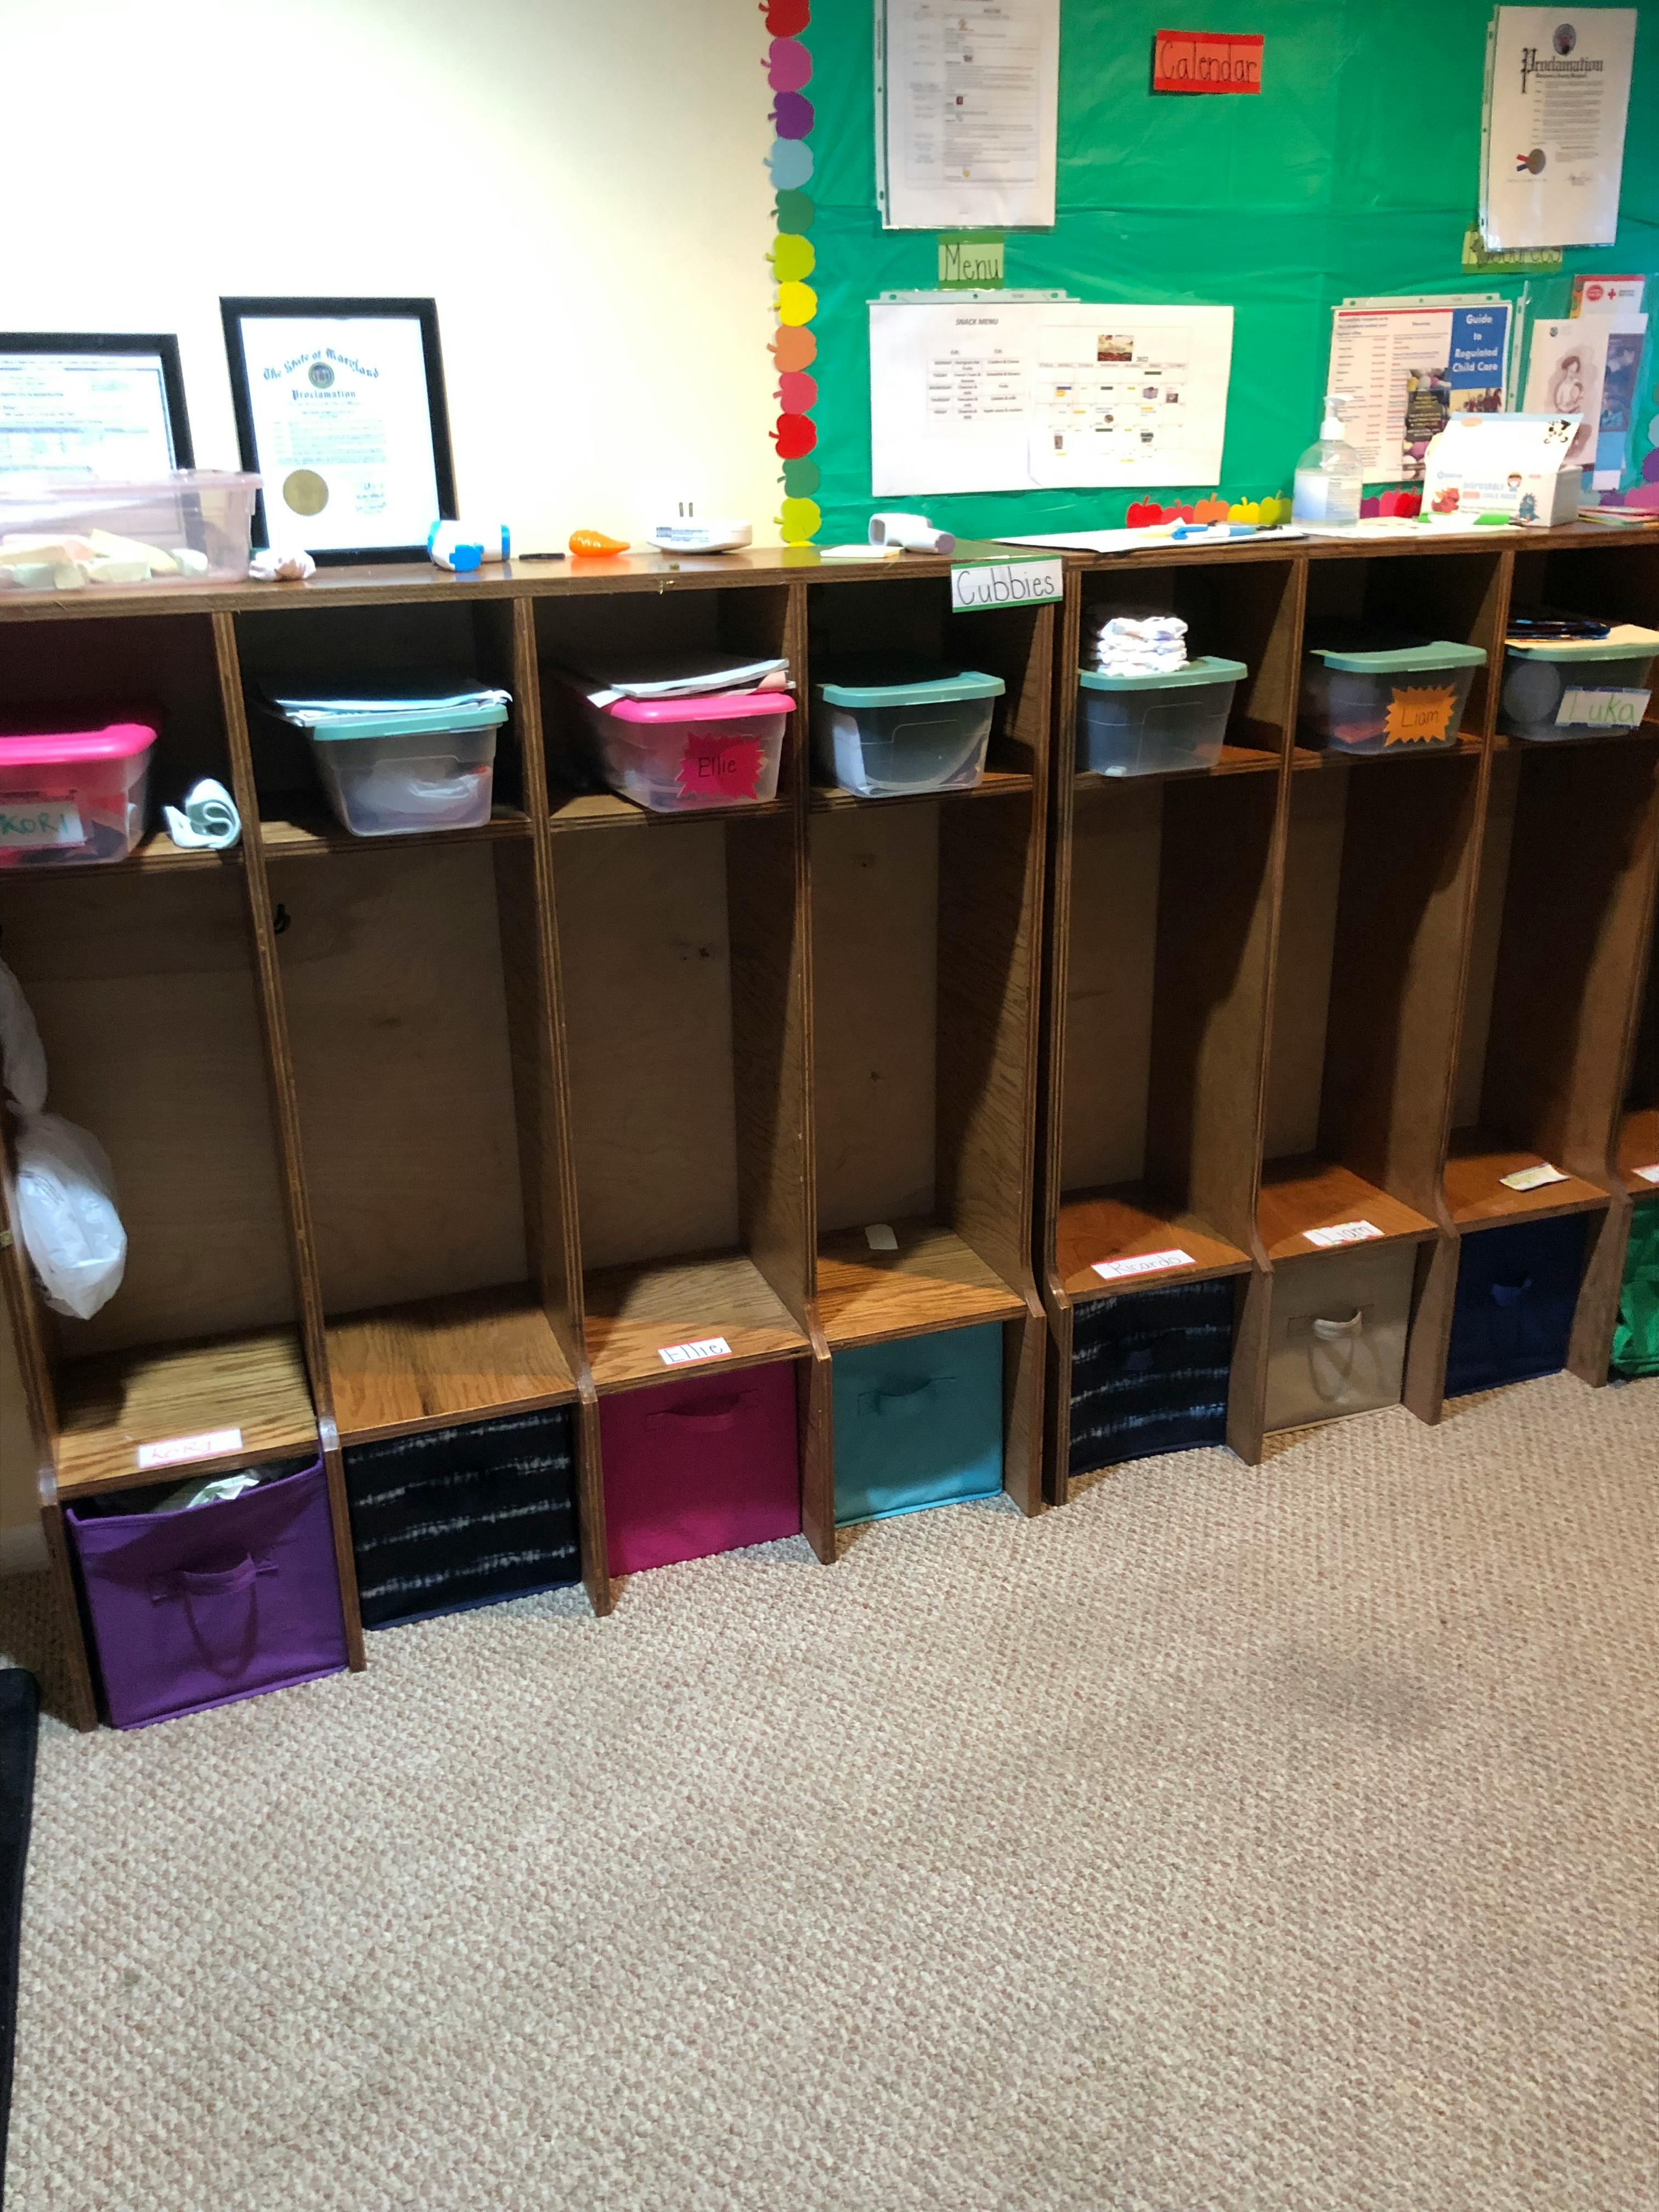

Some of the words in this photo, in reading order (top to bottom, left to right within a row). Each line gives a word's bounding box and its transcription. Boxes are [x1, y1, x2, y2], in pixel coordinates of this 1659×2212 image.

[1161, 40, 1257, 83] Calendar
[1521, 48, 1604, 93] Proclamation
[945, 242, 1000, 281] Menu
[1466, 314, 1493, 324] Guide
[1474, 332, 1482, 341] to
[263, 368, 281, 380] The
[284, 354, 308, 374] State
[312, 349, 321, 360] of
[326, 347, 379, 378] Maryland
[1455, 347, 1498, 360] Regulated
[1452, 363, 1475, 373] Child
[1477, 362, 1499, 371] Care
[292, 390, 356, 400] Proclamation
[957, 566, 1054, 605] Cubbies
[1401, 706, 1438, 727] Liam
[1568, 691, 1635, 724] Luka
[698, 755, 737, 778] Ellie
[1314, 1226, 1374, 1243] Liam
[1107, 1254, 1182, 1275] Ricardo
[664, 1344, 723, 1363] Ellie
